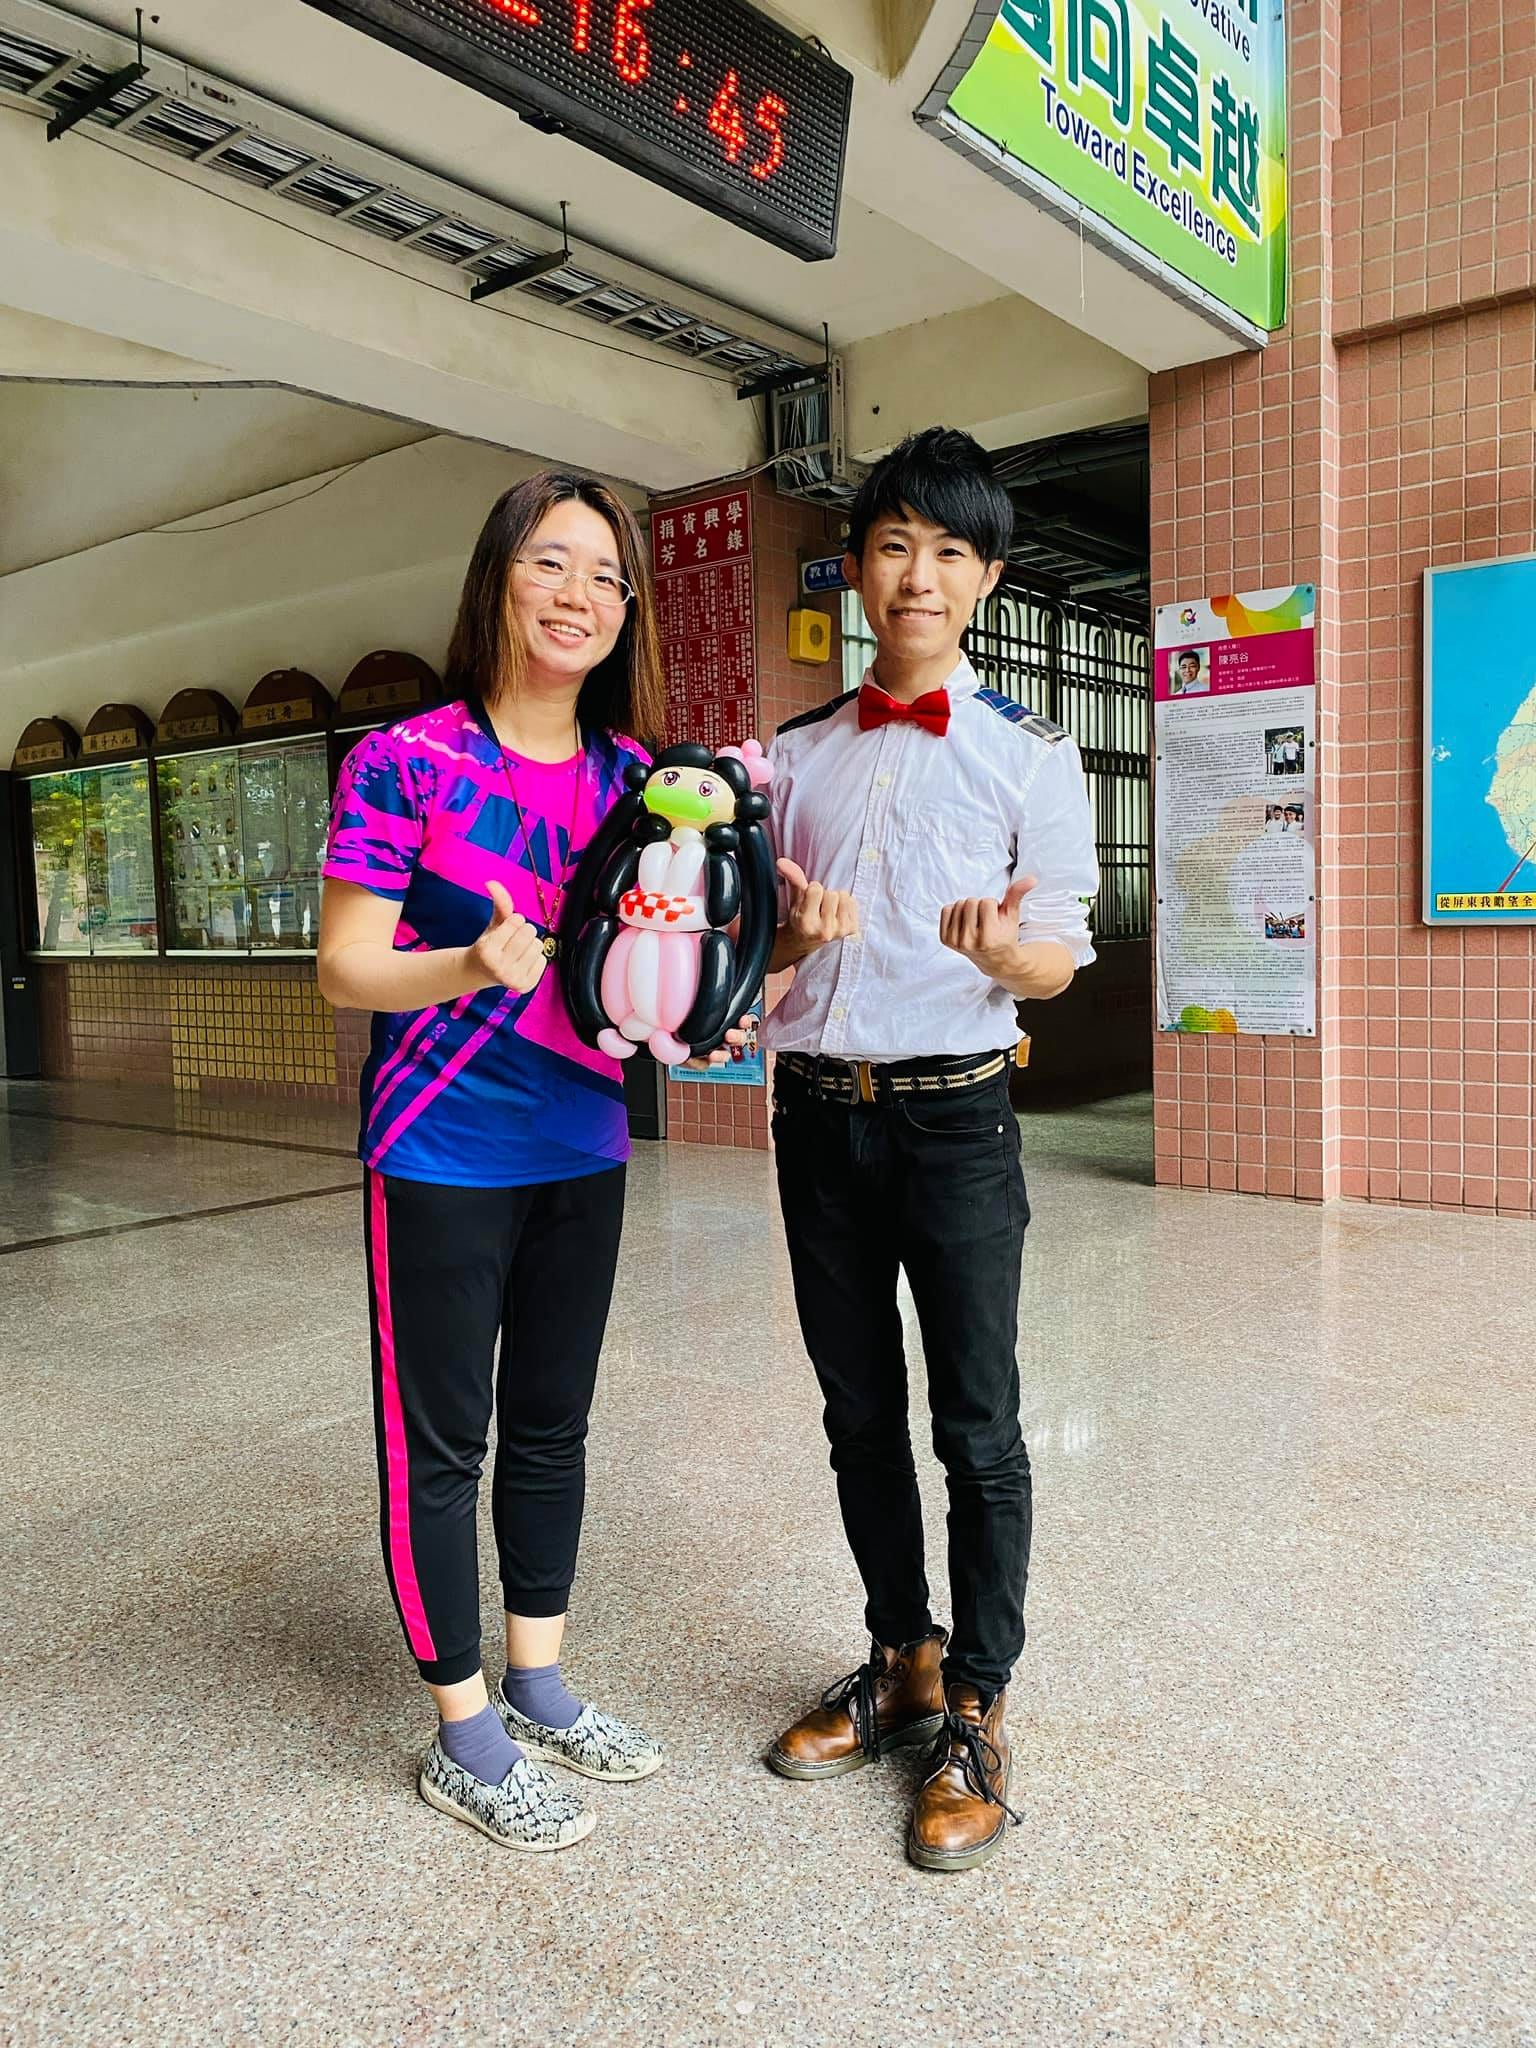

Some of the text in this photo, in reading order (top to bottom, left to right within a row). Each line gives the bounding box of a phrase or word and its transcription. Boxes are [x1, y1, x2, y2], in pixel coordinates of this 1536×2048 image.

[1190, 0, 1250, 62] vative
[1041, 77, 1236, 263] Toward Excellence
[659, 501, 743, 540] 捐資興學
[660, 529, 744, 566] 芳名錄
